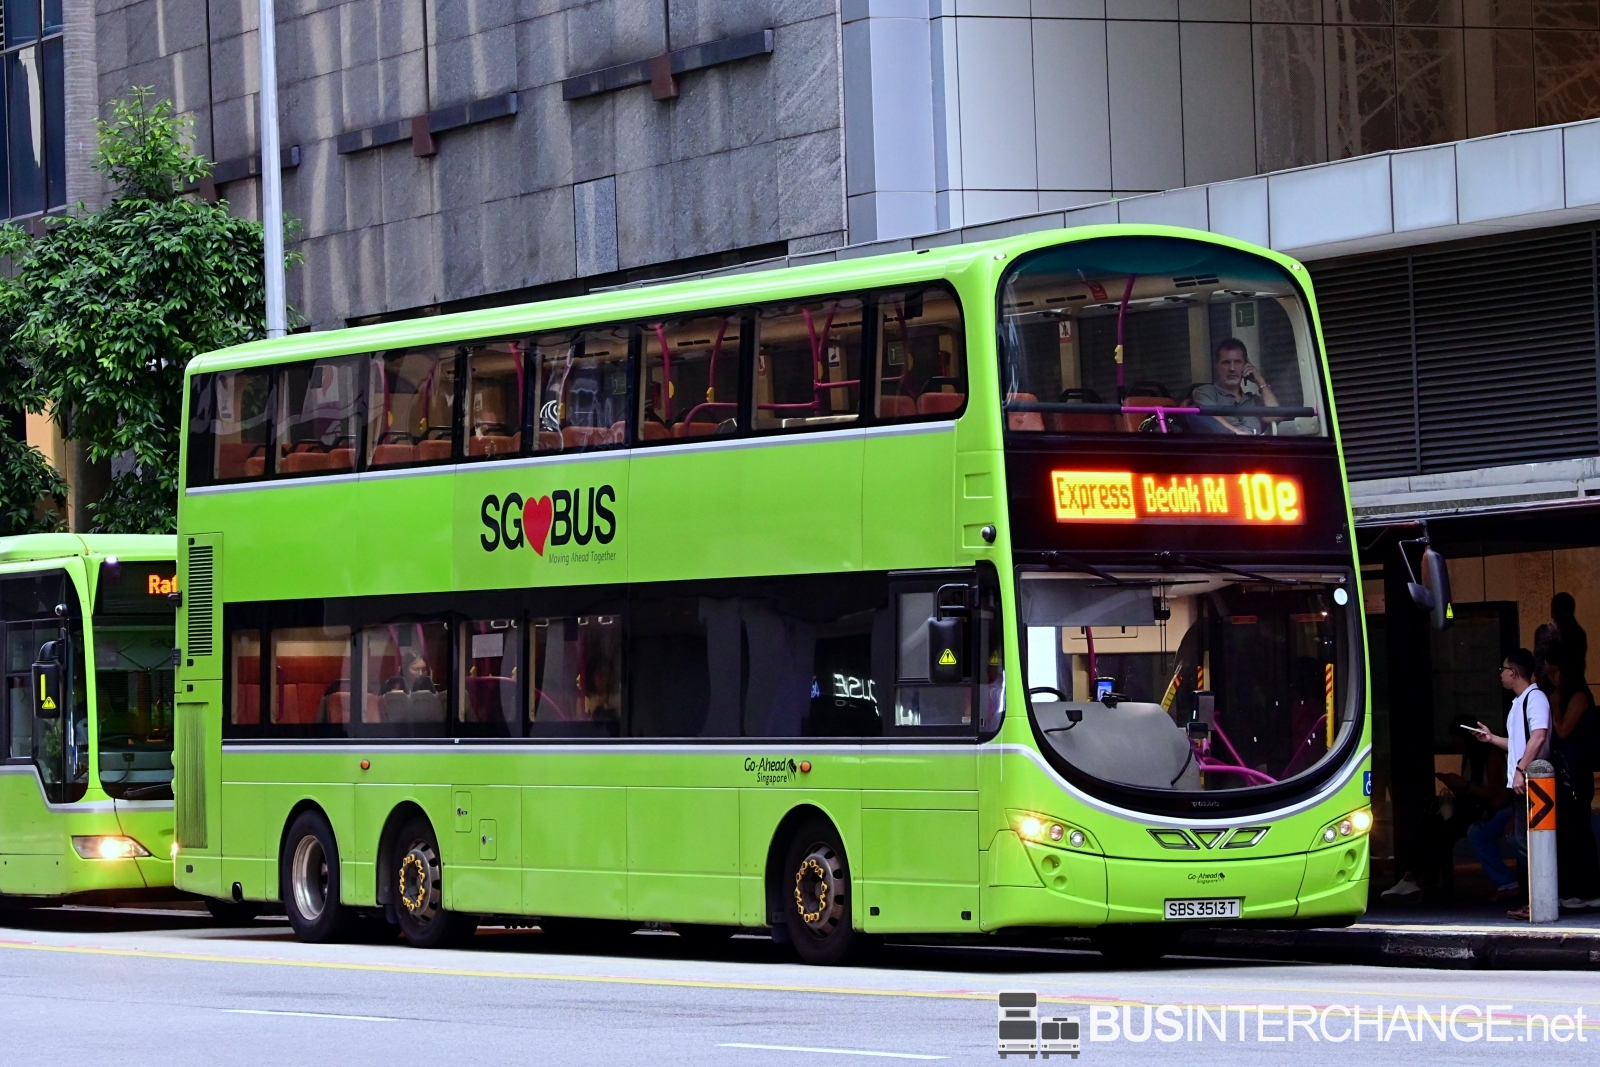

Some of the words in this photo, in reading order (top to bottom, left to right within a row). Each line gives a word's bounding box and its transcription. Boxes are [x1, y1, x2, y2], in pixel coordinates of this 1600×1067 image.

[1056, 477, 1131, 516] Express
[1142, 477, 1201, 513] Bedok
[1202, 477, 1228, 513] Rd
[1238, 473, 1299, 521] 10e
[548, 553, 570, 566] Moving
[570, 552, 589, 563] Ahead
[590, 550, 617, 564] Together
[744, 757, 787, 772] Go-Ahead
[756, 772, 788, 786] Singapore
[1187, 872, 1218, 881] Go-Ahead
